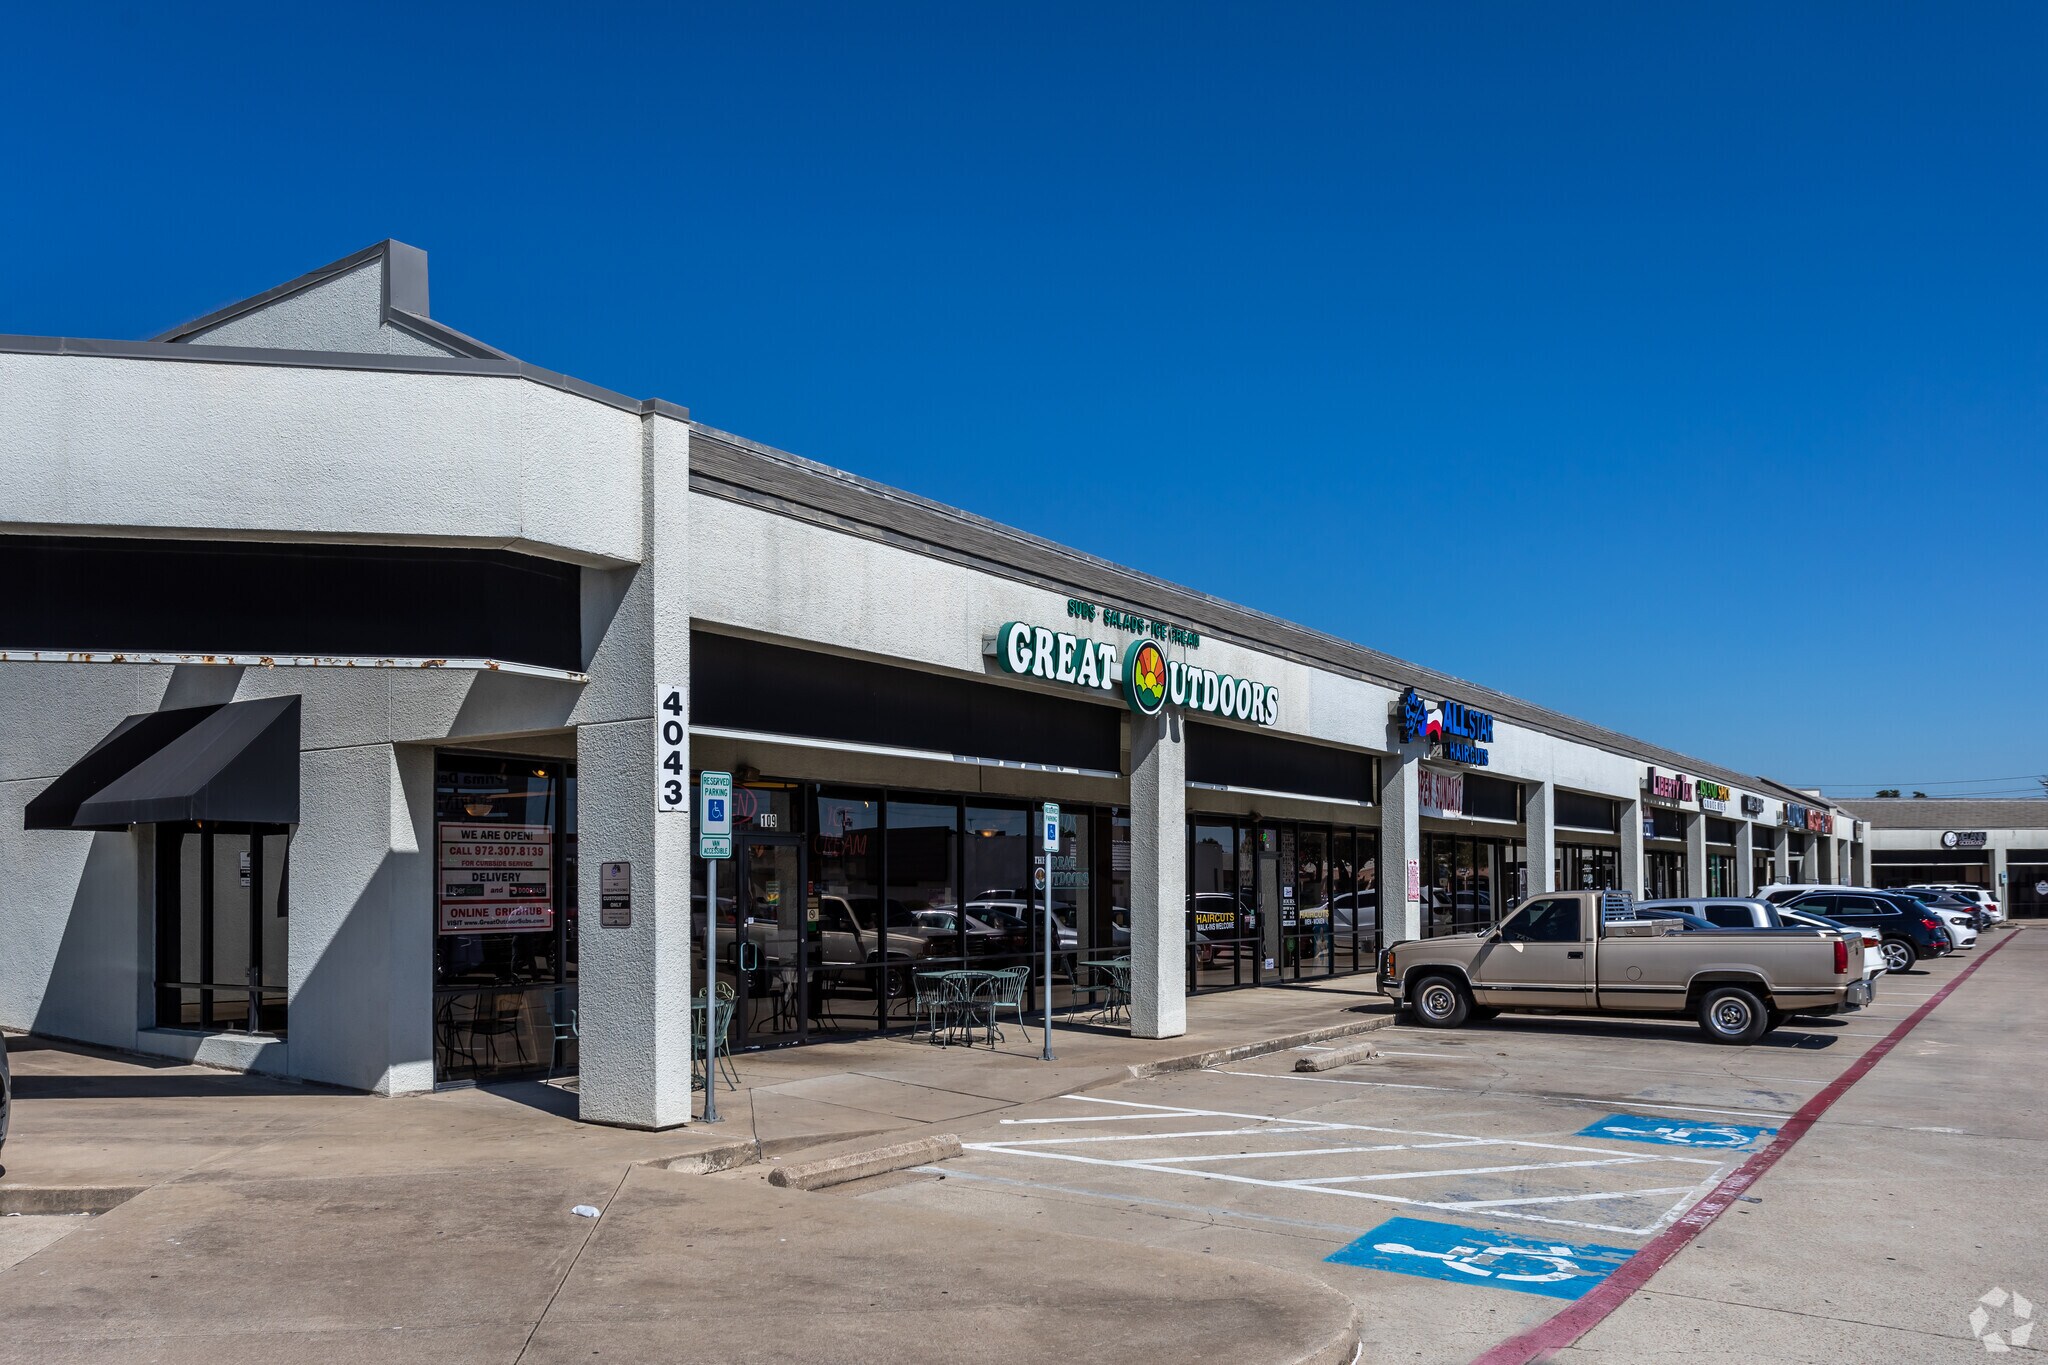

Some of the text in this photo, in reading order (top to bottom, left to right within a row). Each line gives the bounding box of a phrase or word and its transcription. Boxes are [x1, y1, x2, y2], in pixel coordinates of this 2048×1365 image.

[1067, 599, 1200, 646] SUBS SALADS ICE CREAM
[1007, 621, 1117, 690] GREAT
[662, 690, 684, 806] 4043
[1449, 742, 1489, 766] HAIRCUTS
[703, 776, 730, 786] RESERVED
[1652, 767, 1693, 802] LIBERTY TAX
[704, 787, 728, 797] PARKING
[761, 815, 777, 827] 109
[460, 829, 534, 841] WE ARE OPEN!
[811, 832, 869, 856] CREAM
[449, 845, 544, 857] CALL 972.307.8139
[703, 847, 728, 855] ACCESSIBLE
[471, 872, 522, 882] DELIVERY
[448, 885, 466, 895] Uber
[490, 886, 504, 894] and
[450, 907, 543, 918] ONLINE GRUBHUB
[1196, 912, 1235, 924] HAIRCUTS
[1299, 909, 1330, 919] HAIRCUTS
[447, 919, 463, 927] VISIT
